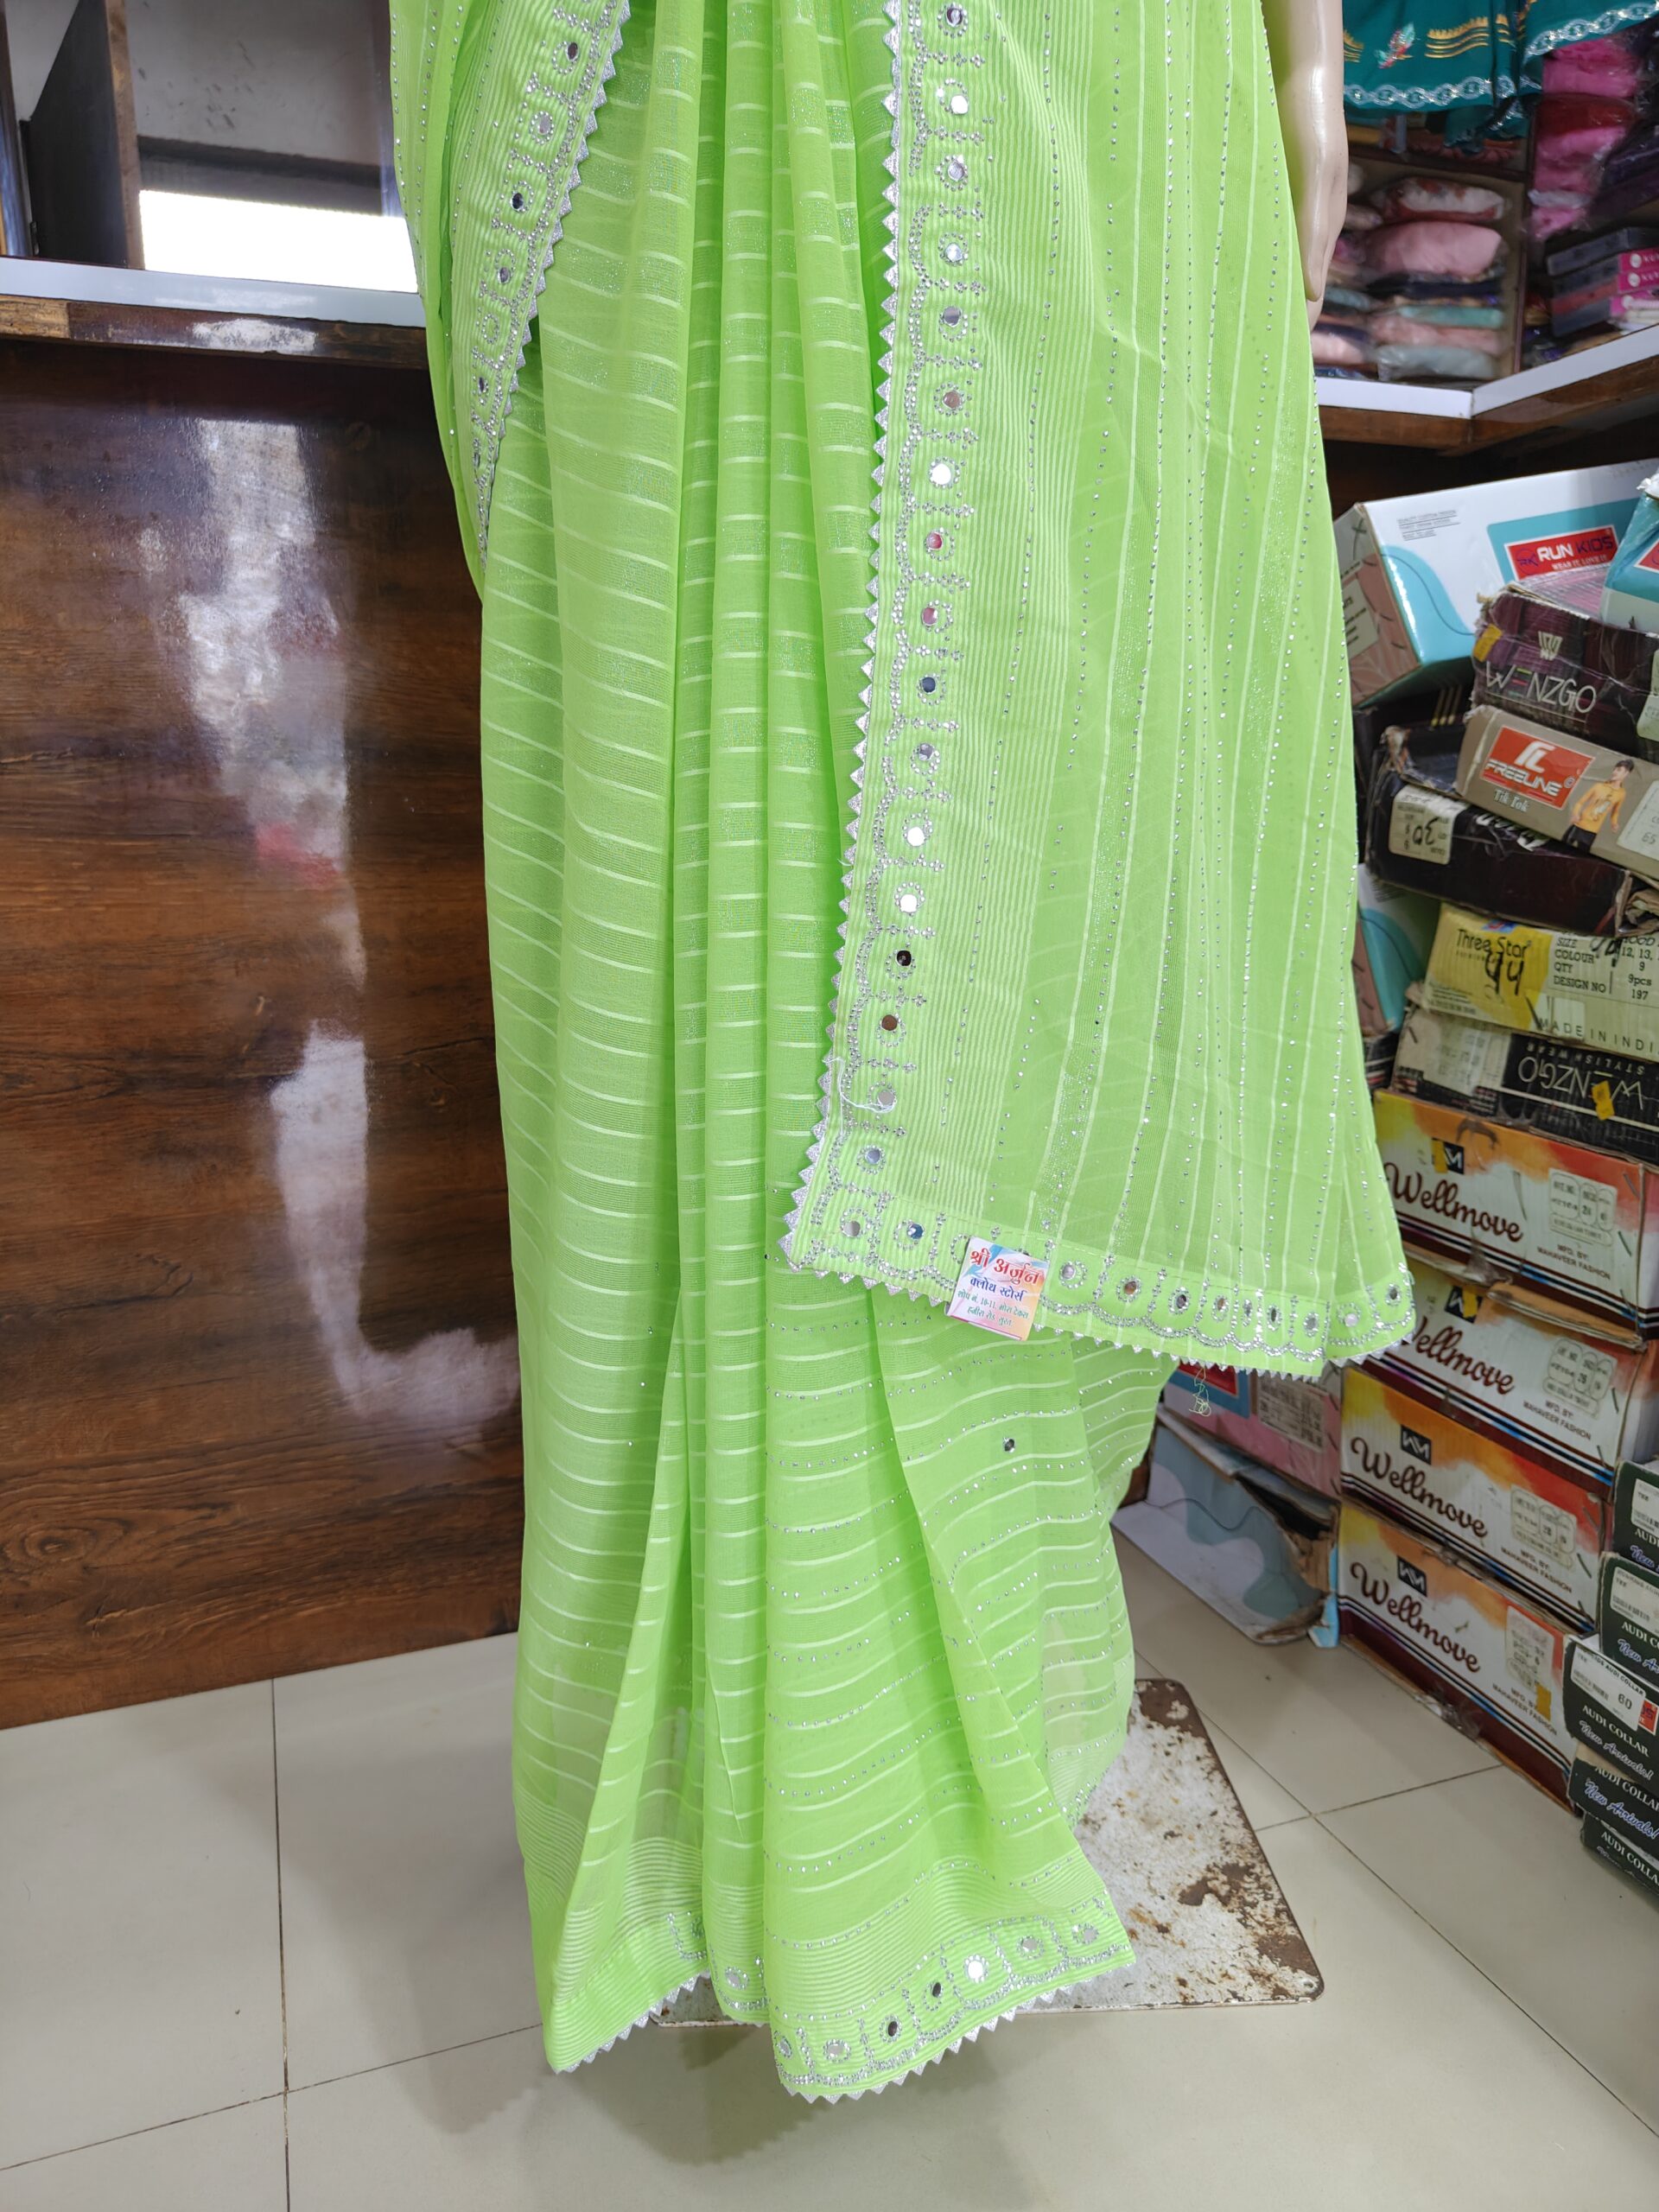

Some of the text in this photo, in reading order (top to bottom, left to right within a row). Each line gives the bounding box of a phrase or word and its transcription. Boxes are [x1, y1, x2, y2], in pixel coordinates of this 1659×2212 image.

[1536, 537, 1613, 562] RUN KIDS
[1485, 759, 1562, 796] FREELINE
[1456, 928, 1492, 952] Three
[1497, 936, 1528, 957] Star
[1556, 938, 1578, 949] SIZE
[1554, 949, 1595, 963] COLOUR
[1554, 962, 1573, 973] QTY
[1553, 976, 1606, 993] DESIGN NO
[1628, 974, 1652, 987] 9pcs
[1631, 988, 1649, 1001] 197
[1538, 1017, 1659, 1053] MADE IN INDI
[1384, 1162, 1523, 1242] Wellmove
[1578, 1262, 1611, 1280] FASHION
[1560, 1420, 1592, 1440] FASHION
[1351, 1436, 1488, 1538] Wellmove
[1350, 1562, 1480, 1673] Wellmove
[1621, 1621, 1648, 1643] AUDI
[1605, 1664, 1620, 1678] AUDI
[1620, 1675, 1644, 1696] COLLAR
[1618, 1693, 1632, 1710] 60
[1580, 1719, 1603, 1745] New
[1582, 1705, 1607, 1727] AUDI
[1608, 1723, 1649, 1758] COLLAR
[1595, 1766, 1621, 1786] AUDI
[1584, 1780, 1607, 1806] New
[1601, 1832, 1625, 1856] AUDI
[1626, 1852, 1659, 1886] COLLA
